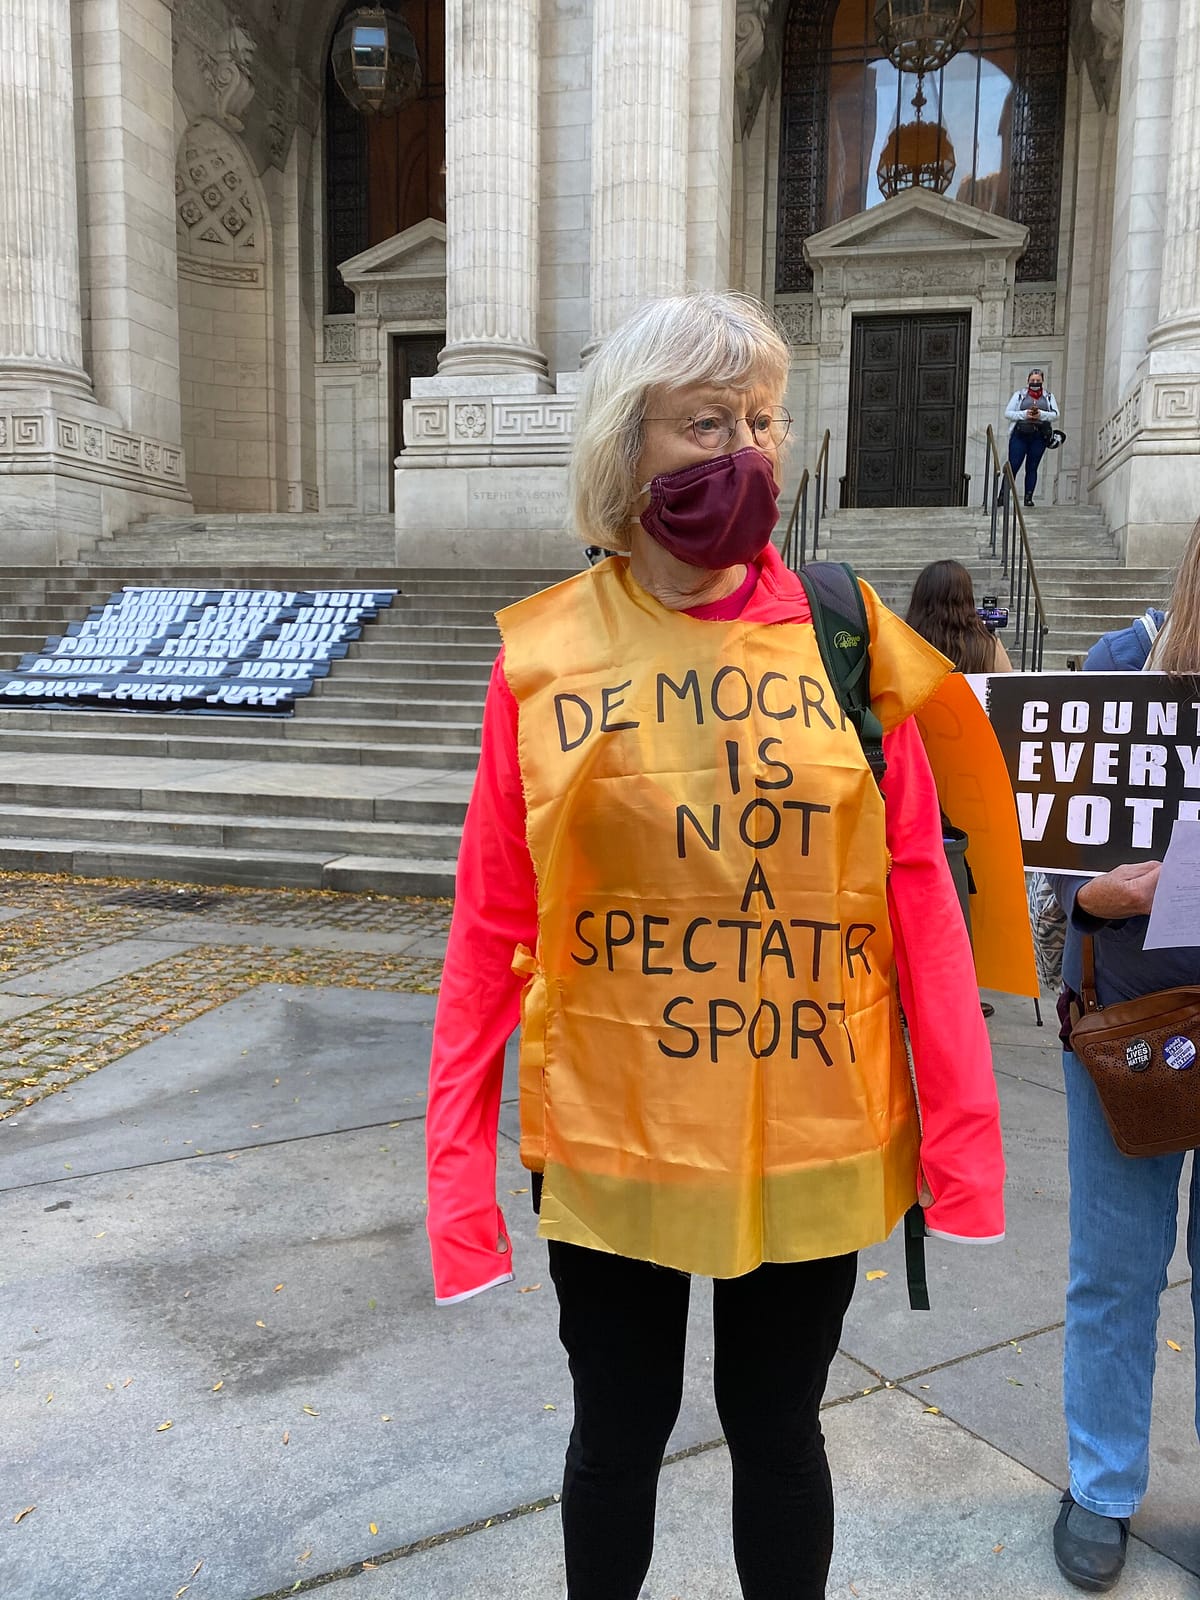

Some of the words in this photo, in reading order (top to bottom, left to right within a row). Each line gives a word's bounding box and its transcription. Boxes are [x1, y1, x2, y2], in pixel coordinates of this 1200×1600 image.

[726, 737, 794, 794] IS
[676, 798, 831, 858] NOT
[740, 857, 775, 912] A
[1126, 1048, 1148, 1060] LIVES
[1127, 1055, 1149, 1066] MATTER
